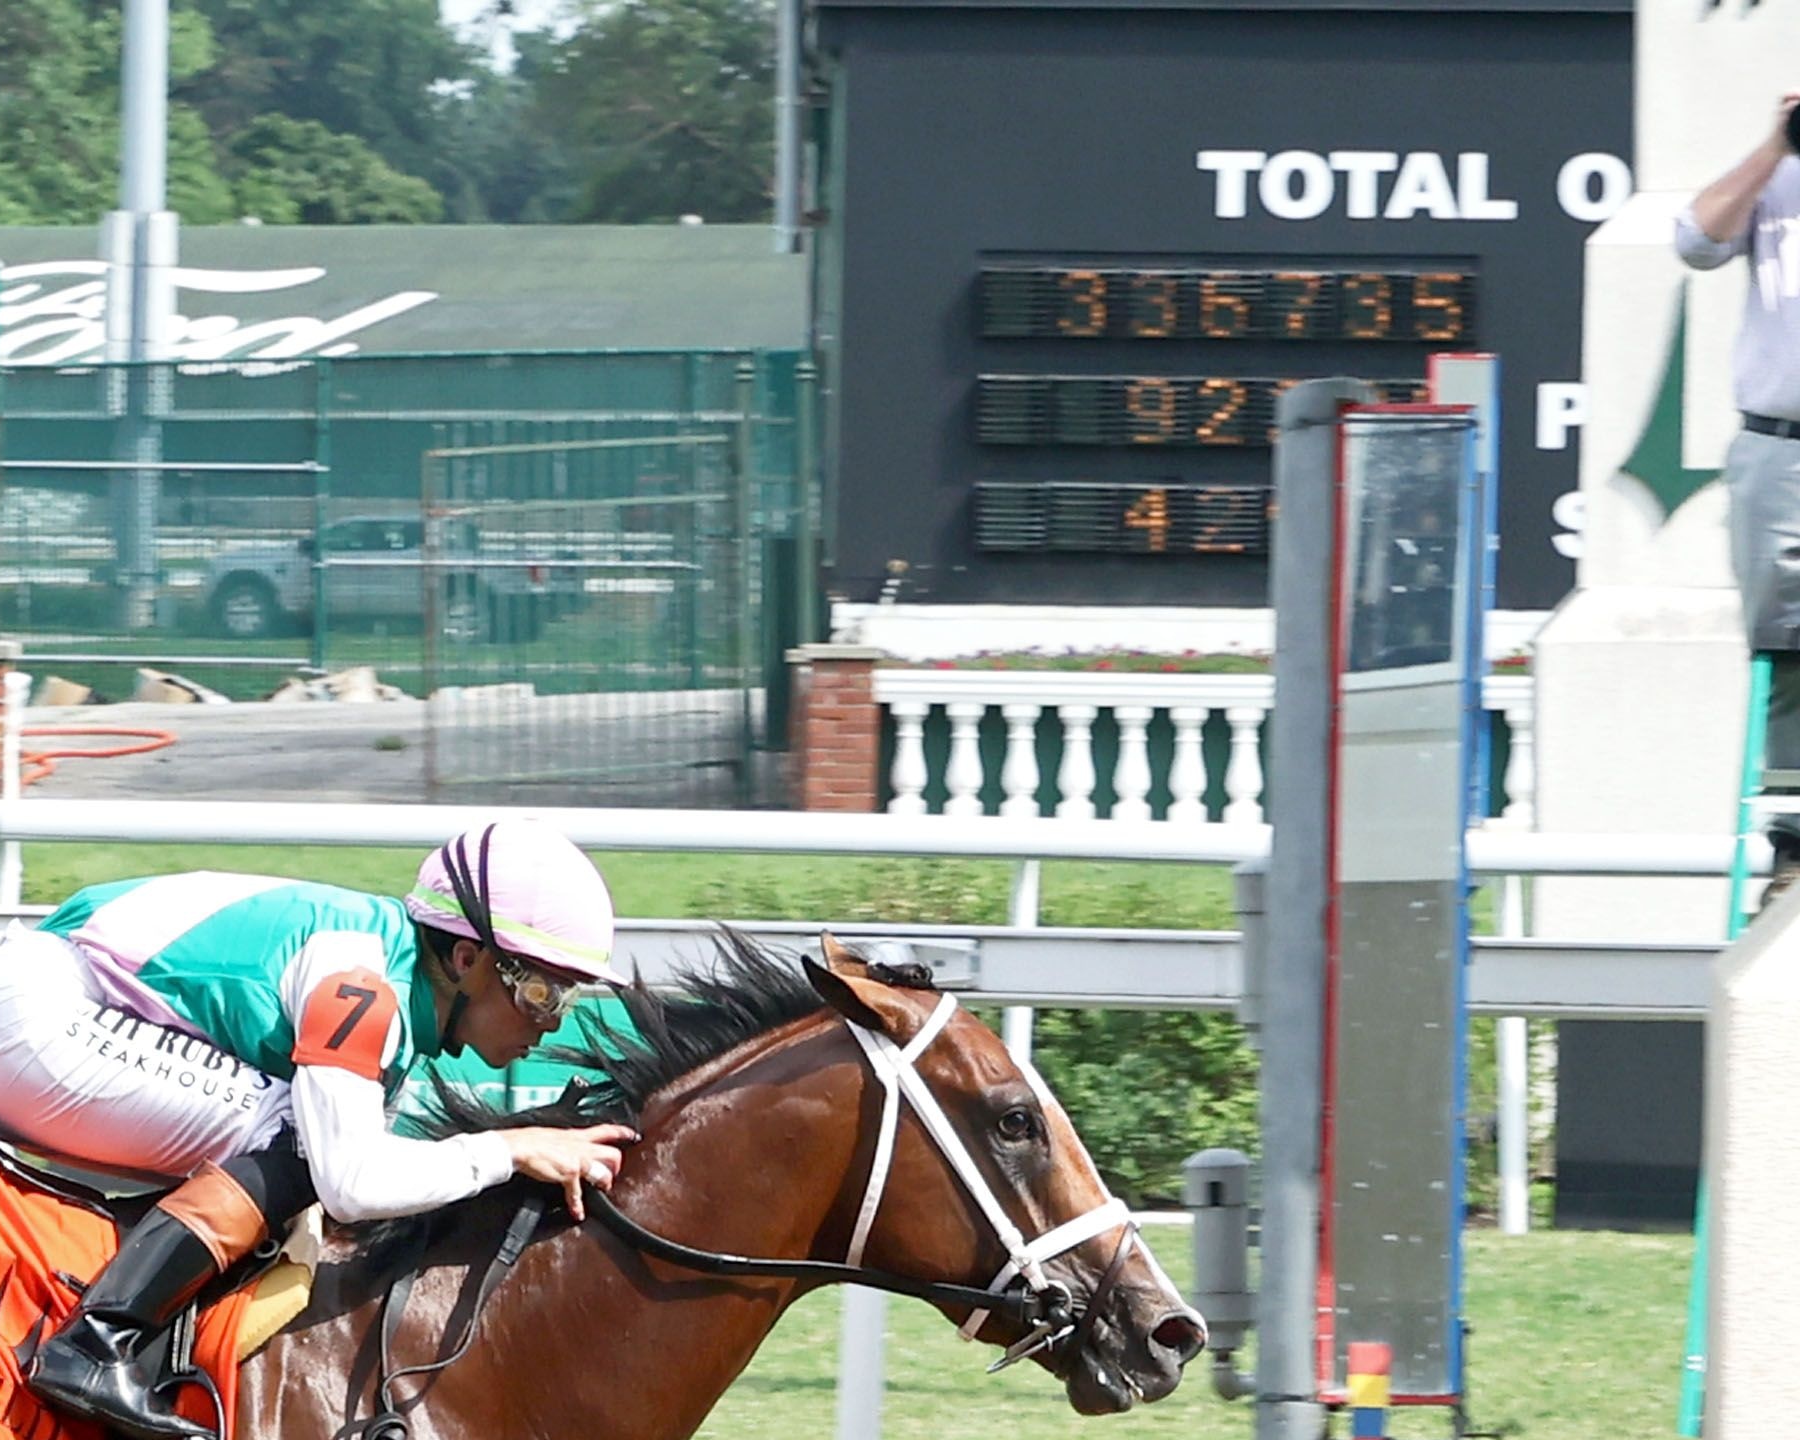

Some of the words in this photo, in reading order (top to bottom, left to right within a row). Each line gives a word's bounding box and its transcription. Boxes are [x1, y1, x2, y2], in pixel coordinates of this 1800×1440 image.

[1197, 150, 1517, 220] TOTAL
[324, 983, 377, 1050] 7
[66, 1022, 258, 1110] STEAKHOUSE
